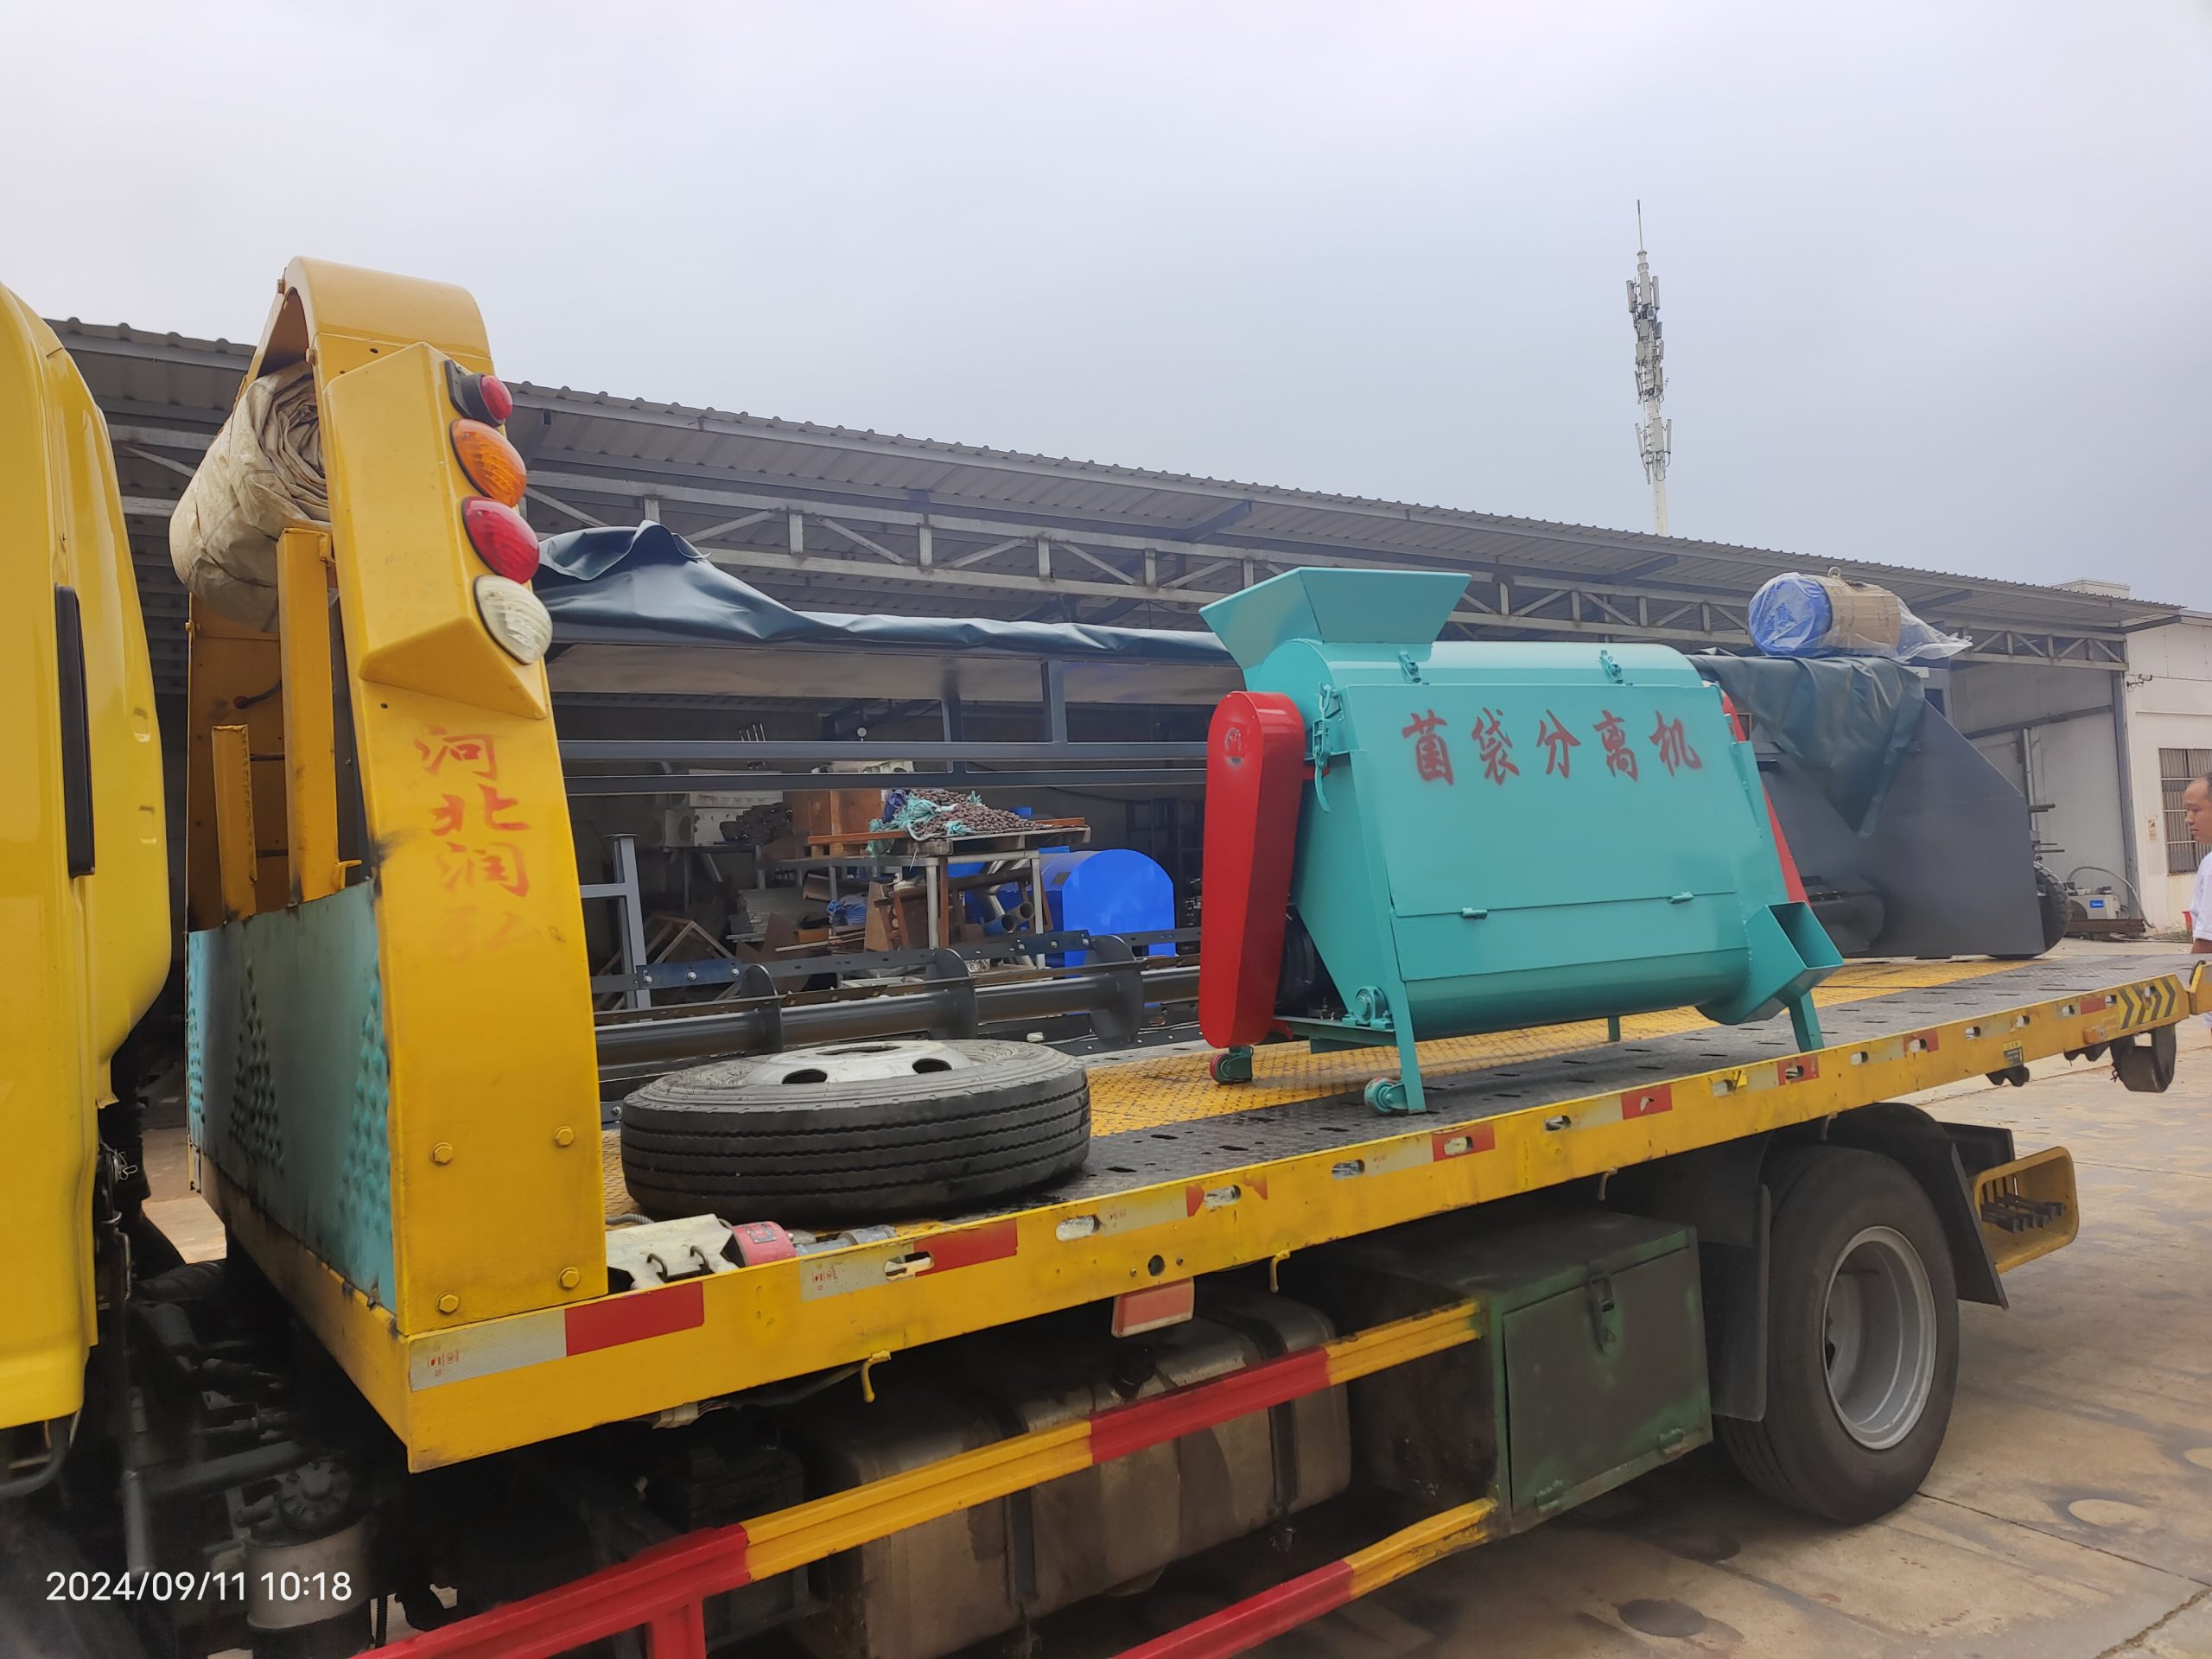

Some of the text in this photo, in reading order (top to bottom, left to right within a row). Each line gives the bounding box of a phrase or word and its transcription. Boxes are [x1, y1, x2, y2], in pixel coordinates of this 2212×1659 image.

[1402, 707, 1703, 786] 菌袋分离机
